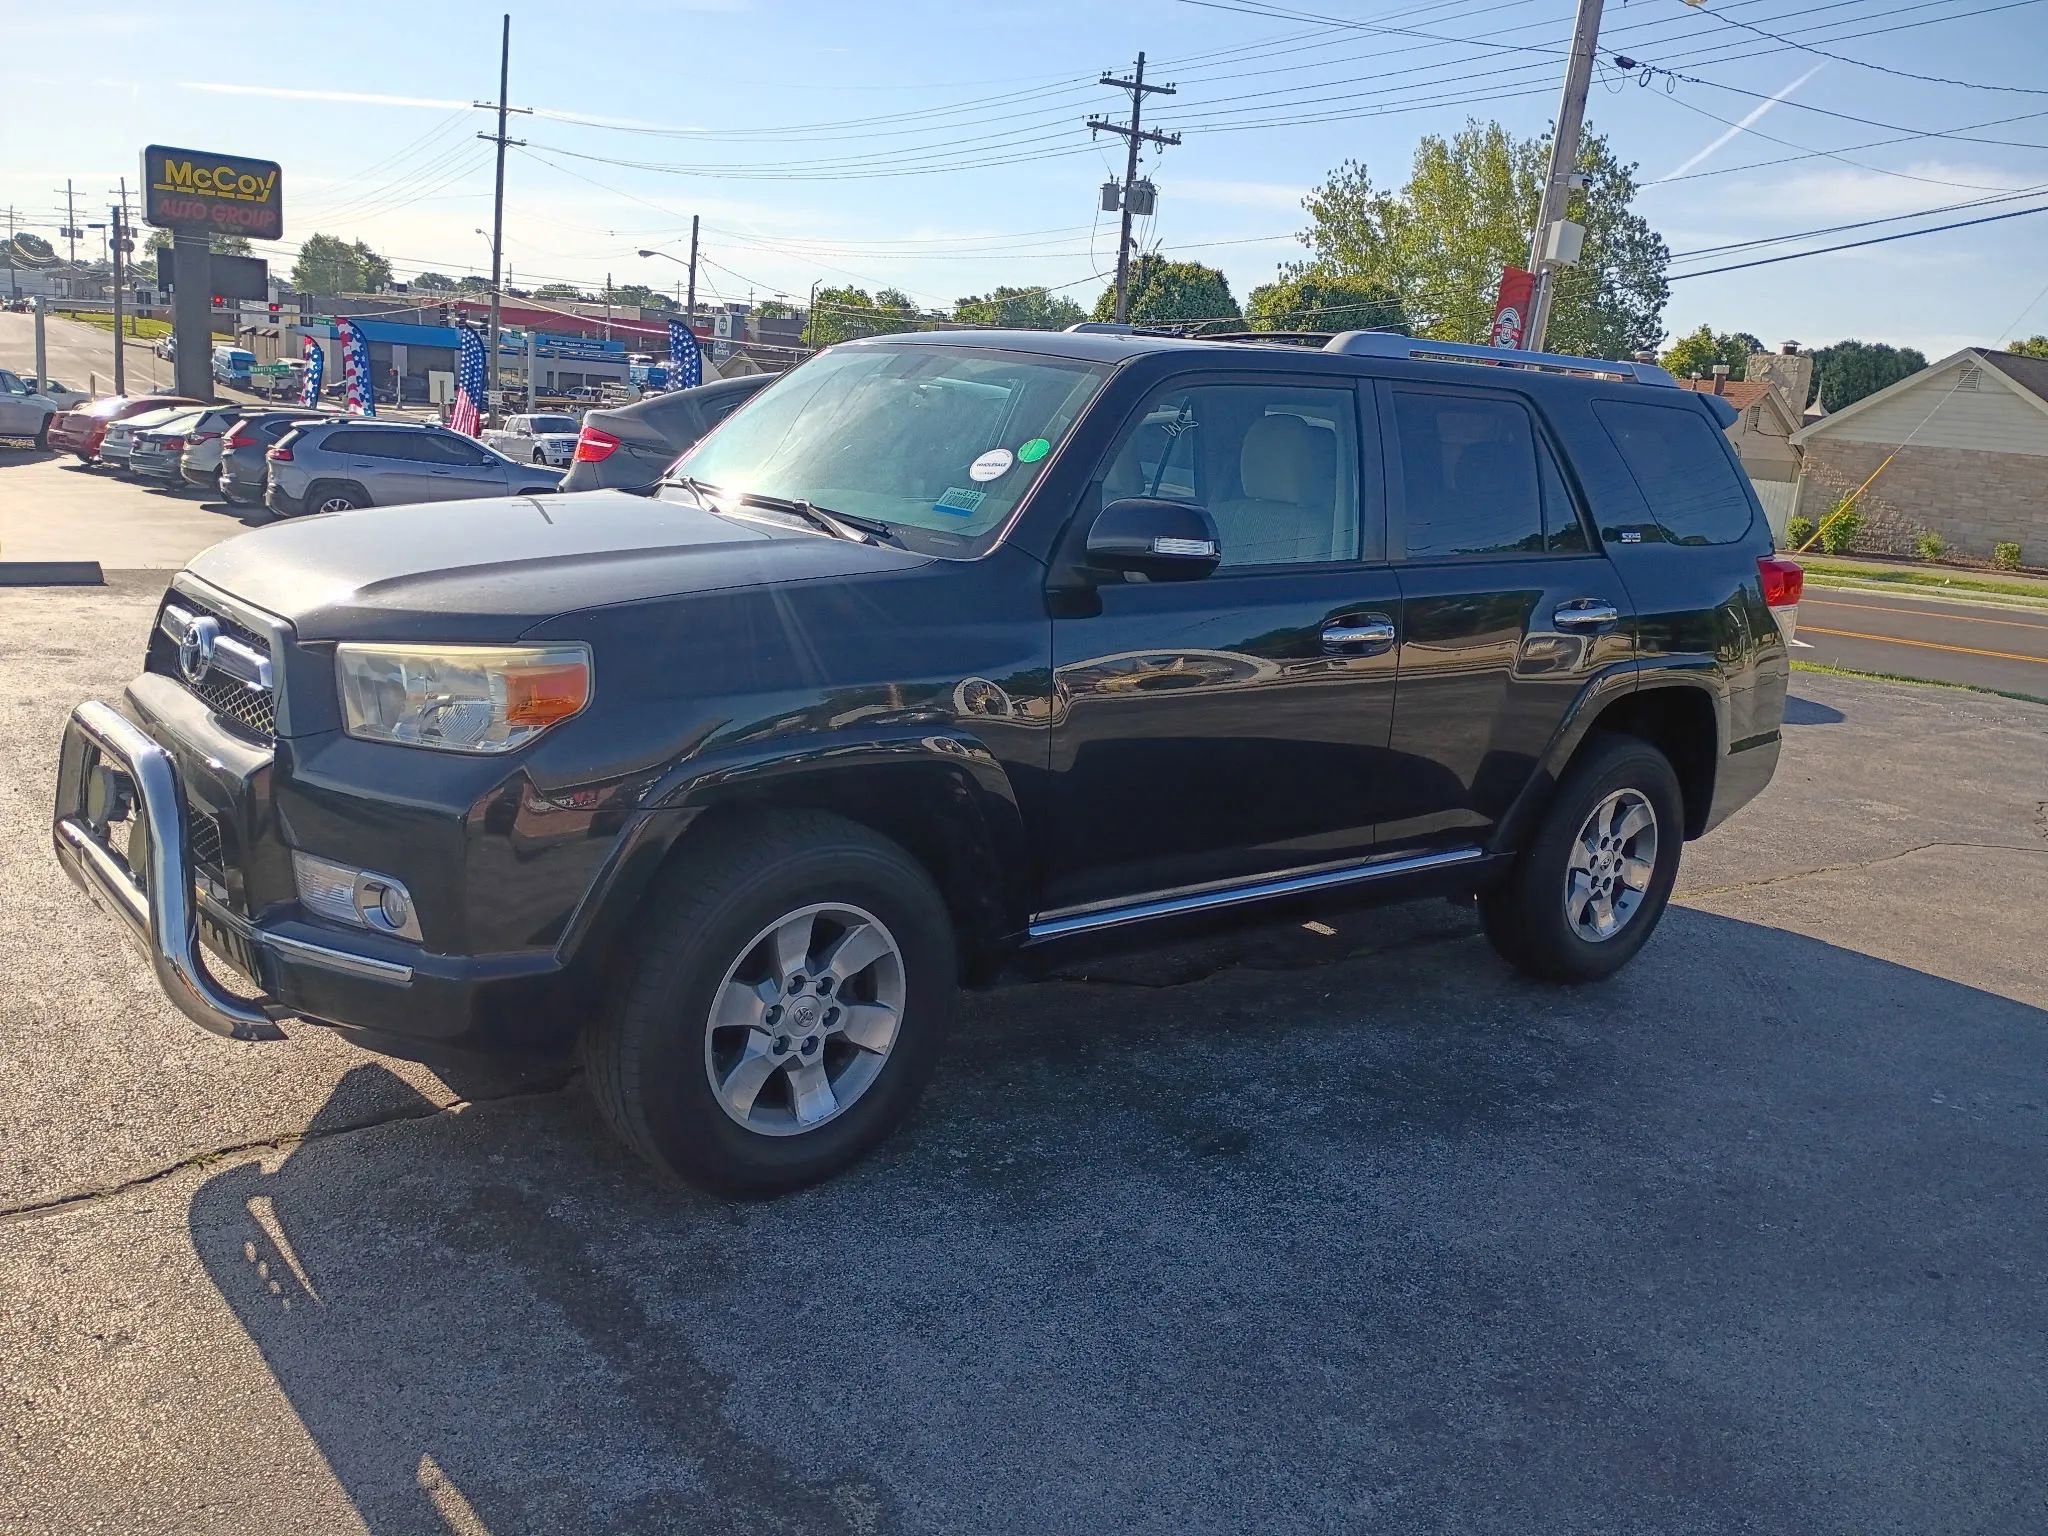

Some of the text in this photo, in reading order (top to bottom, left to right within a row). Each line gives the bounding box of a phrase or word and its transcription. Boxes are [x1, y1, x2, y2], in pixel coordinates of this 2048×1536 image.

[165, 159, 276, 201] McCoy
[160, 199, 276, 227] AUTO GROUP
